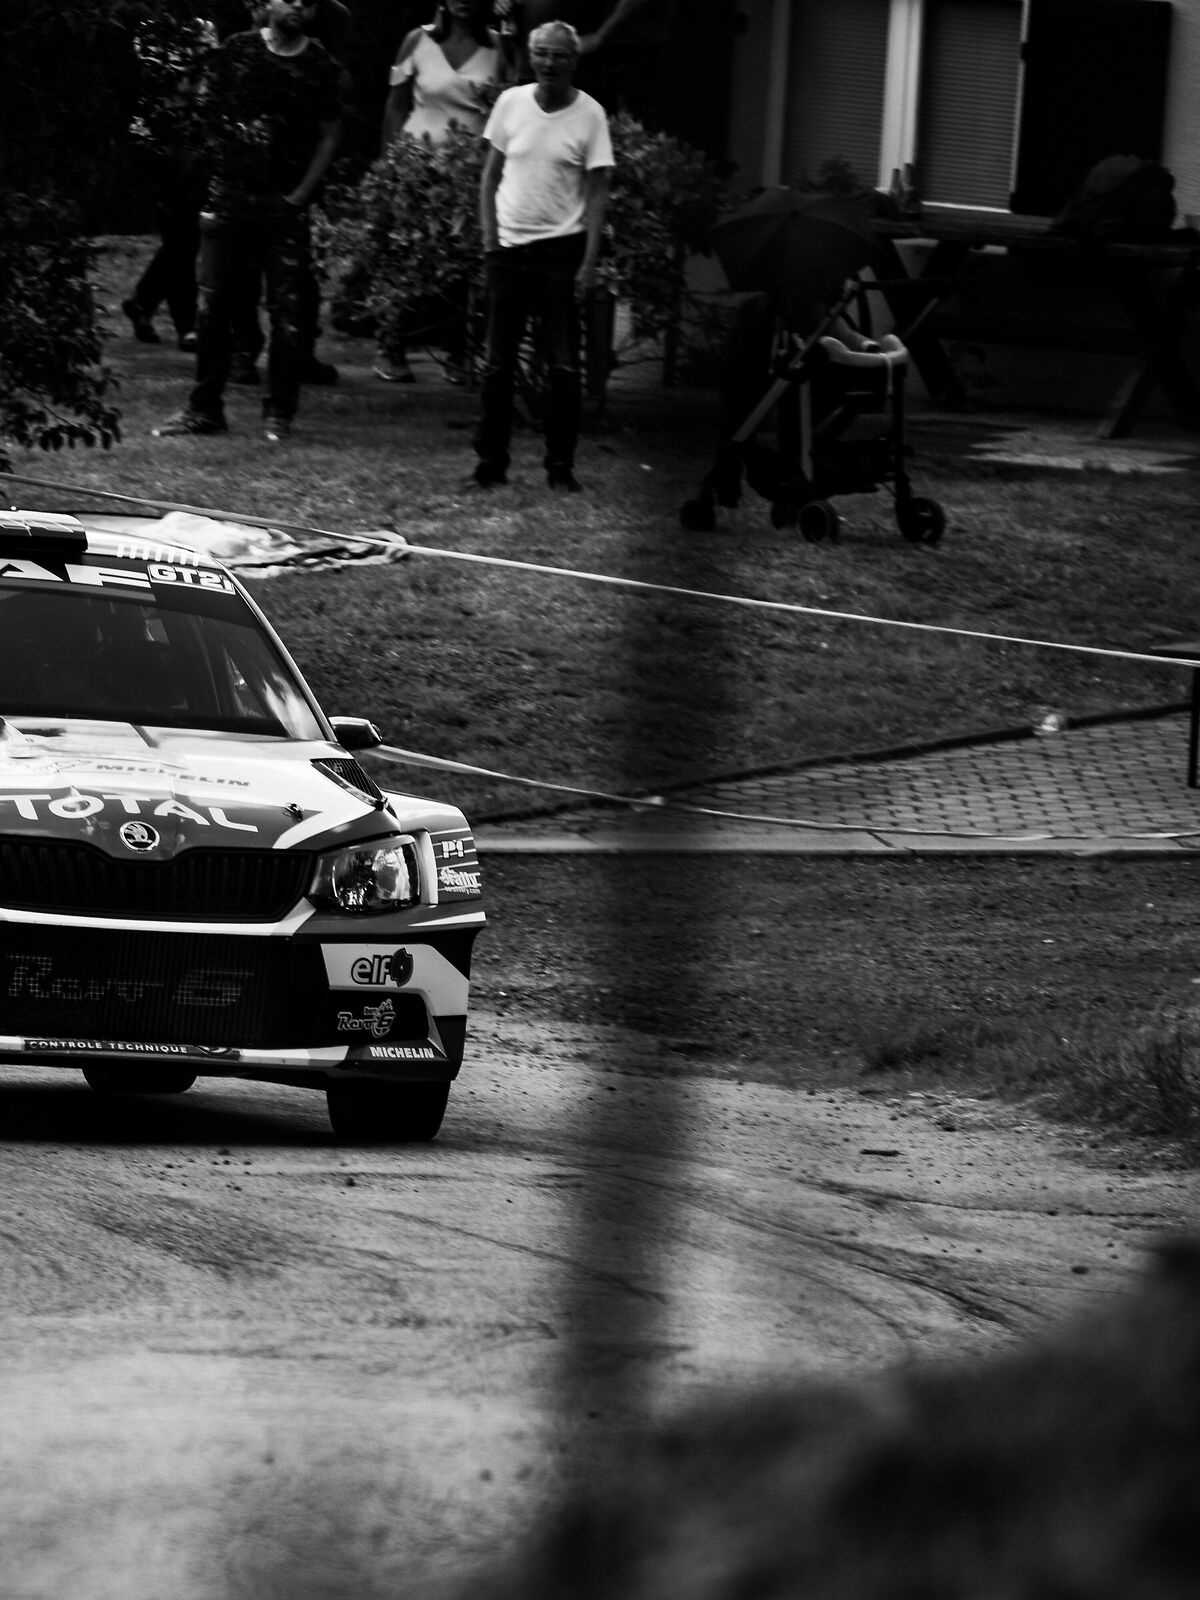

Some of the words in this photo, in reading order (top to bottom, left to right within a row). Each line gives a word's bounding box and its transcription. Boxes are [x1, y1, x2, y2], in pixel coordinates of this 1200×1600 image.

[351, 955, 393, 985] elf
[29, 1040, 102, 1049] CONTROLE
[109, 1043, 187, 1053] TECHNIQUE
[369, 1046, 435, 1058] MICHELIN
